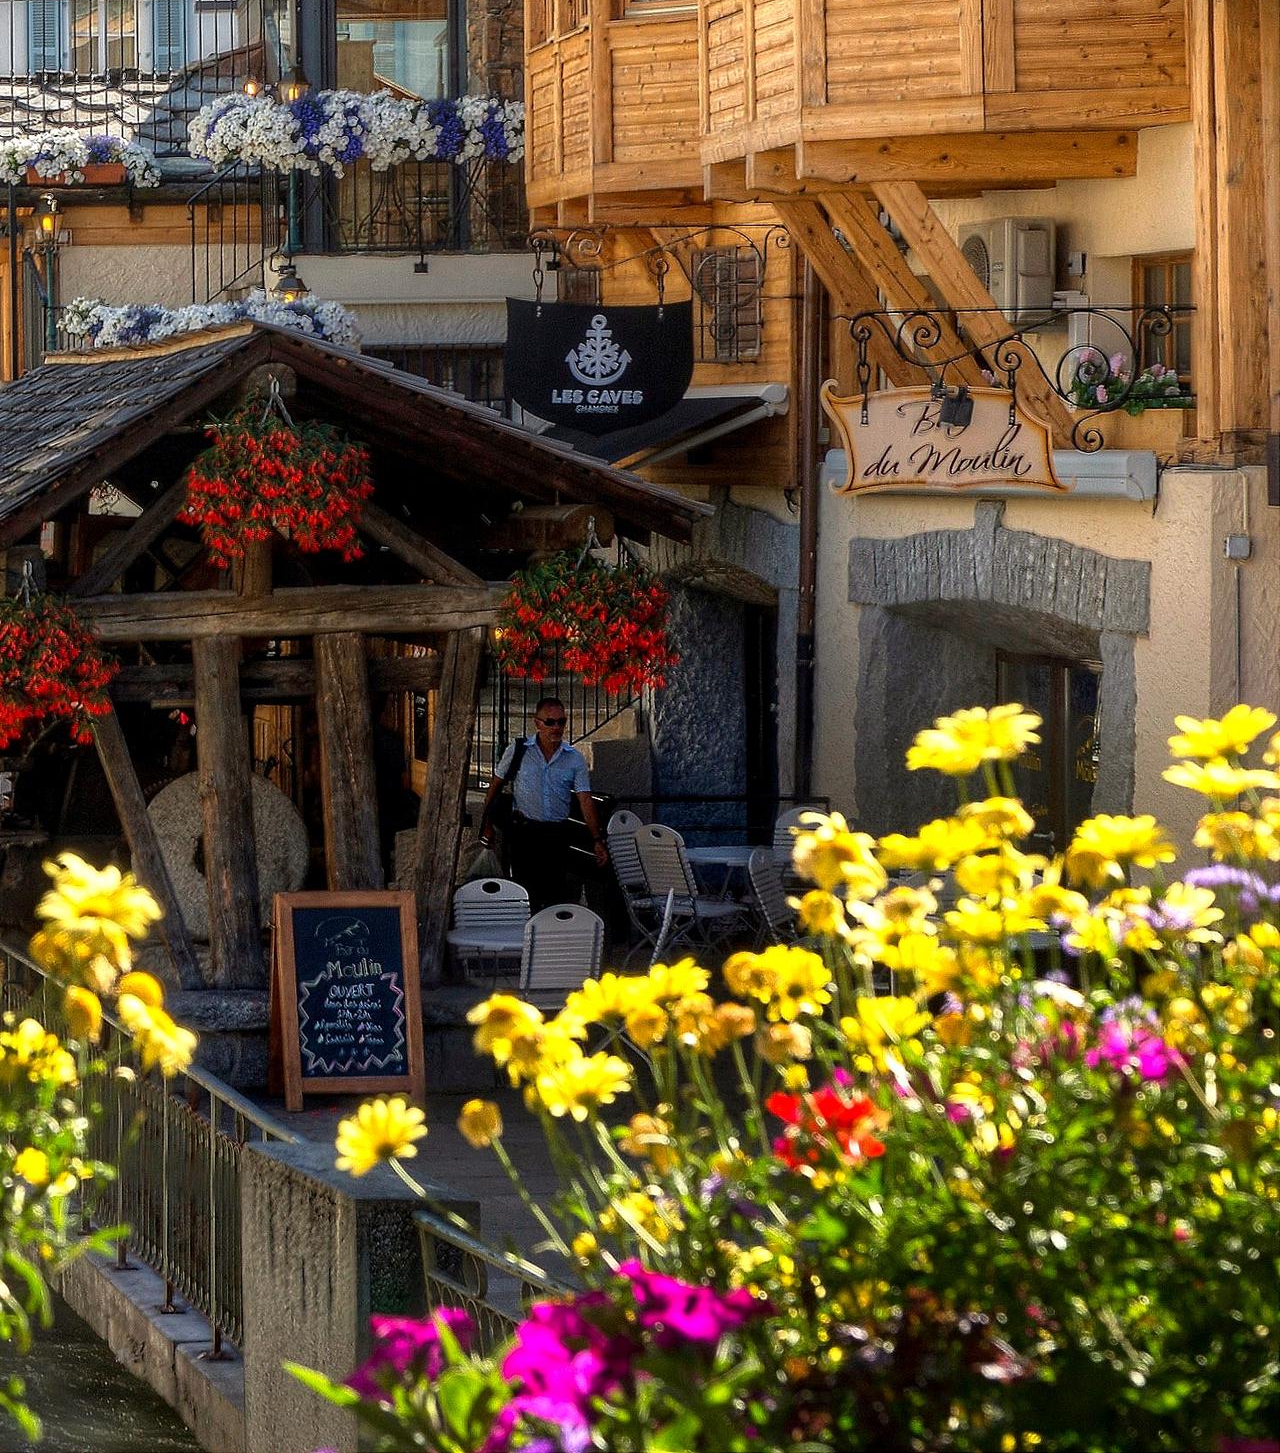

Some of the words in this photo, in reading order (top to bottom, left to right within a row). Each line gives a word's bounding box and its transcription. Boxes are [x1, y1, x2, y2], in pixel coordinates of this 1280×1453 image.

[551, 389, 584, 404] LES
[586, 389, 644, 405] CAVES
[862, 444, 900, 478] du
[908, 423, 1034, 478] Moulin
[326, 957, 383, 979] Moulin
[329, 983, 376, 999] OUVERT
